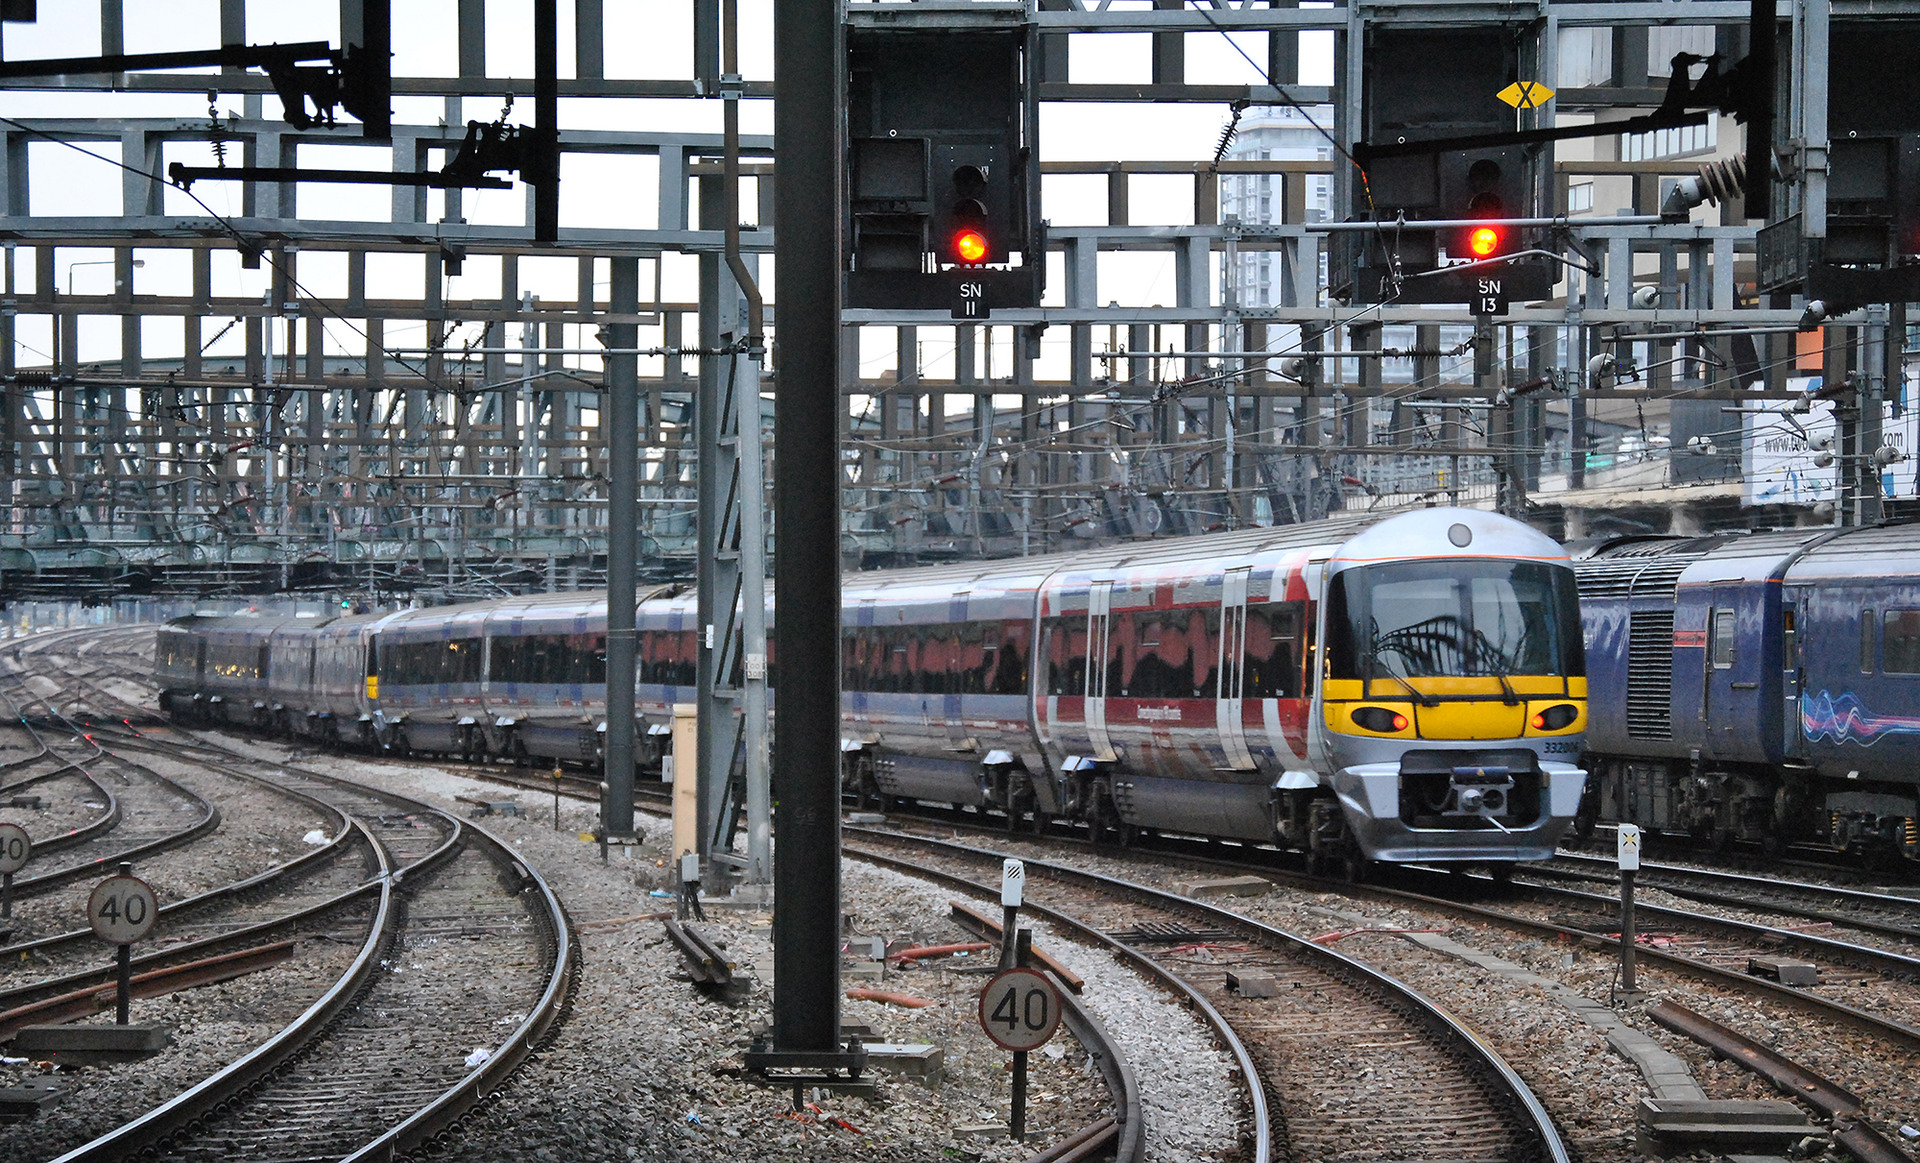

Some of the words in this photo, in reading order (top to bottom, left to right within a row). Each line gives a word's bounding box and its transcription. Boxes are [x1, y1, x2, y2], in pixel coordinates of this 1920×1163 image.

[960, 283, 982, 298] SN
[1478, 279, 1501, 294] SN
[1482, 297, 1497, 312] 13
[98, 893, 147, 926] 40
[990, 987, 1048, 1032] 40
